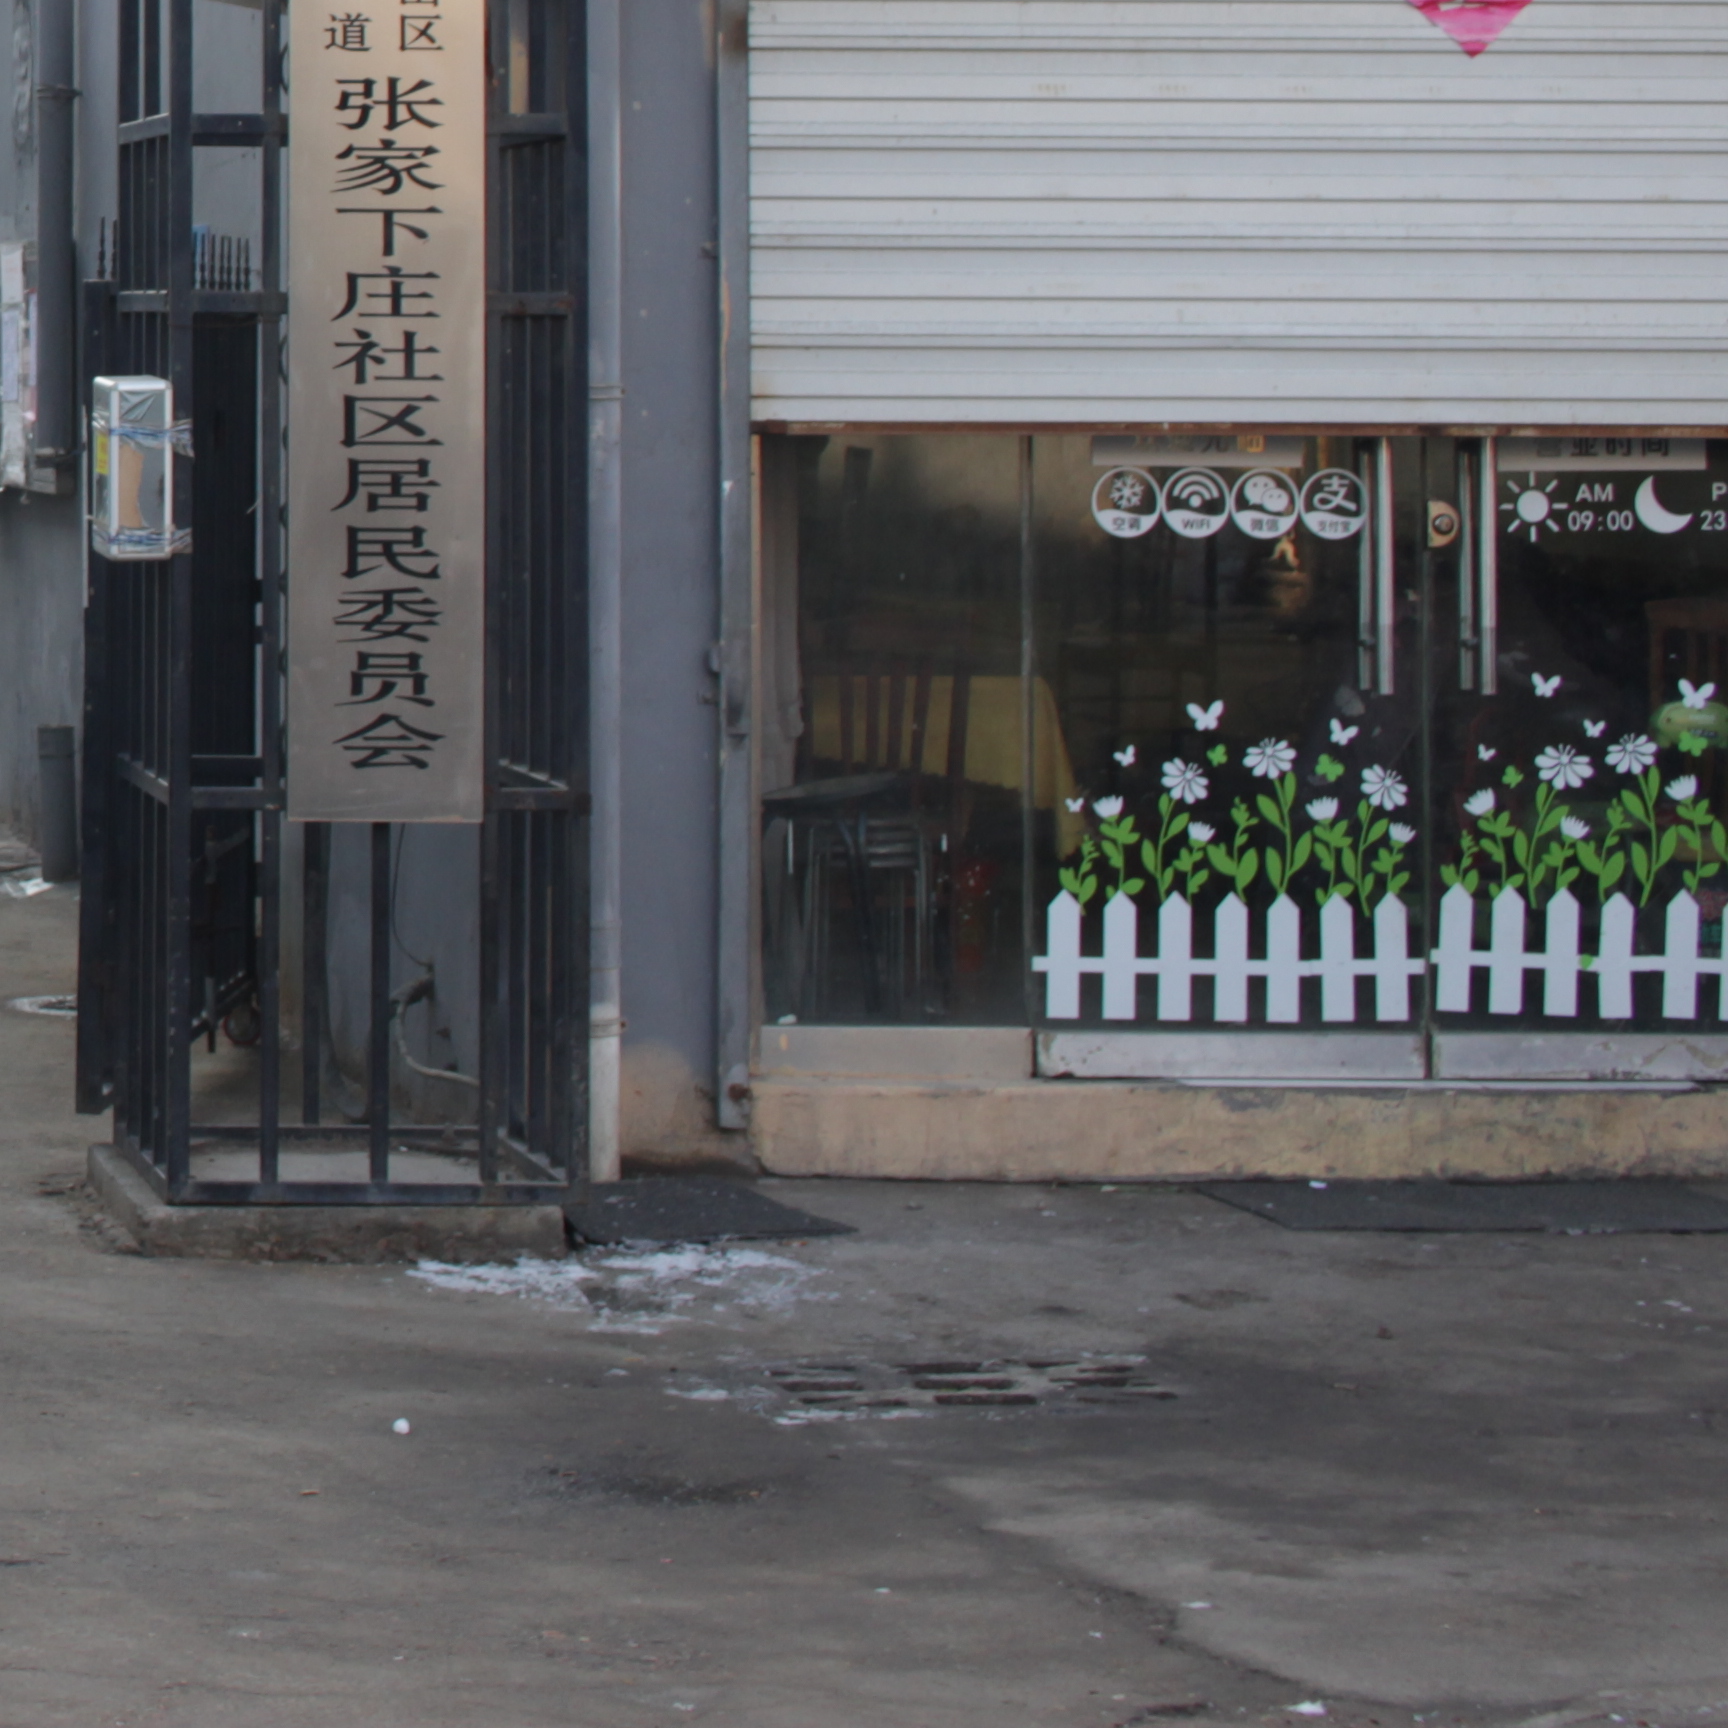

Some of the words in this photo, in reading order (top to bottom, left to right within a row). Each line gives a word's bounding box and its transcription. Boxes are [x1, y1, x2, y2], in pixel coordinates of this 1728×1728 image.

[330, 76, 446, 770] 张家下庄社区居民委员会
[1575, 483, 1614, 502] AM
[1112, 516, 1142, 532] 空调
[1250, 517, 1280, 532] 微信
